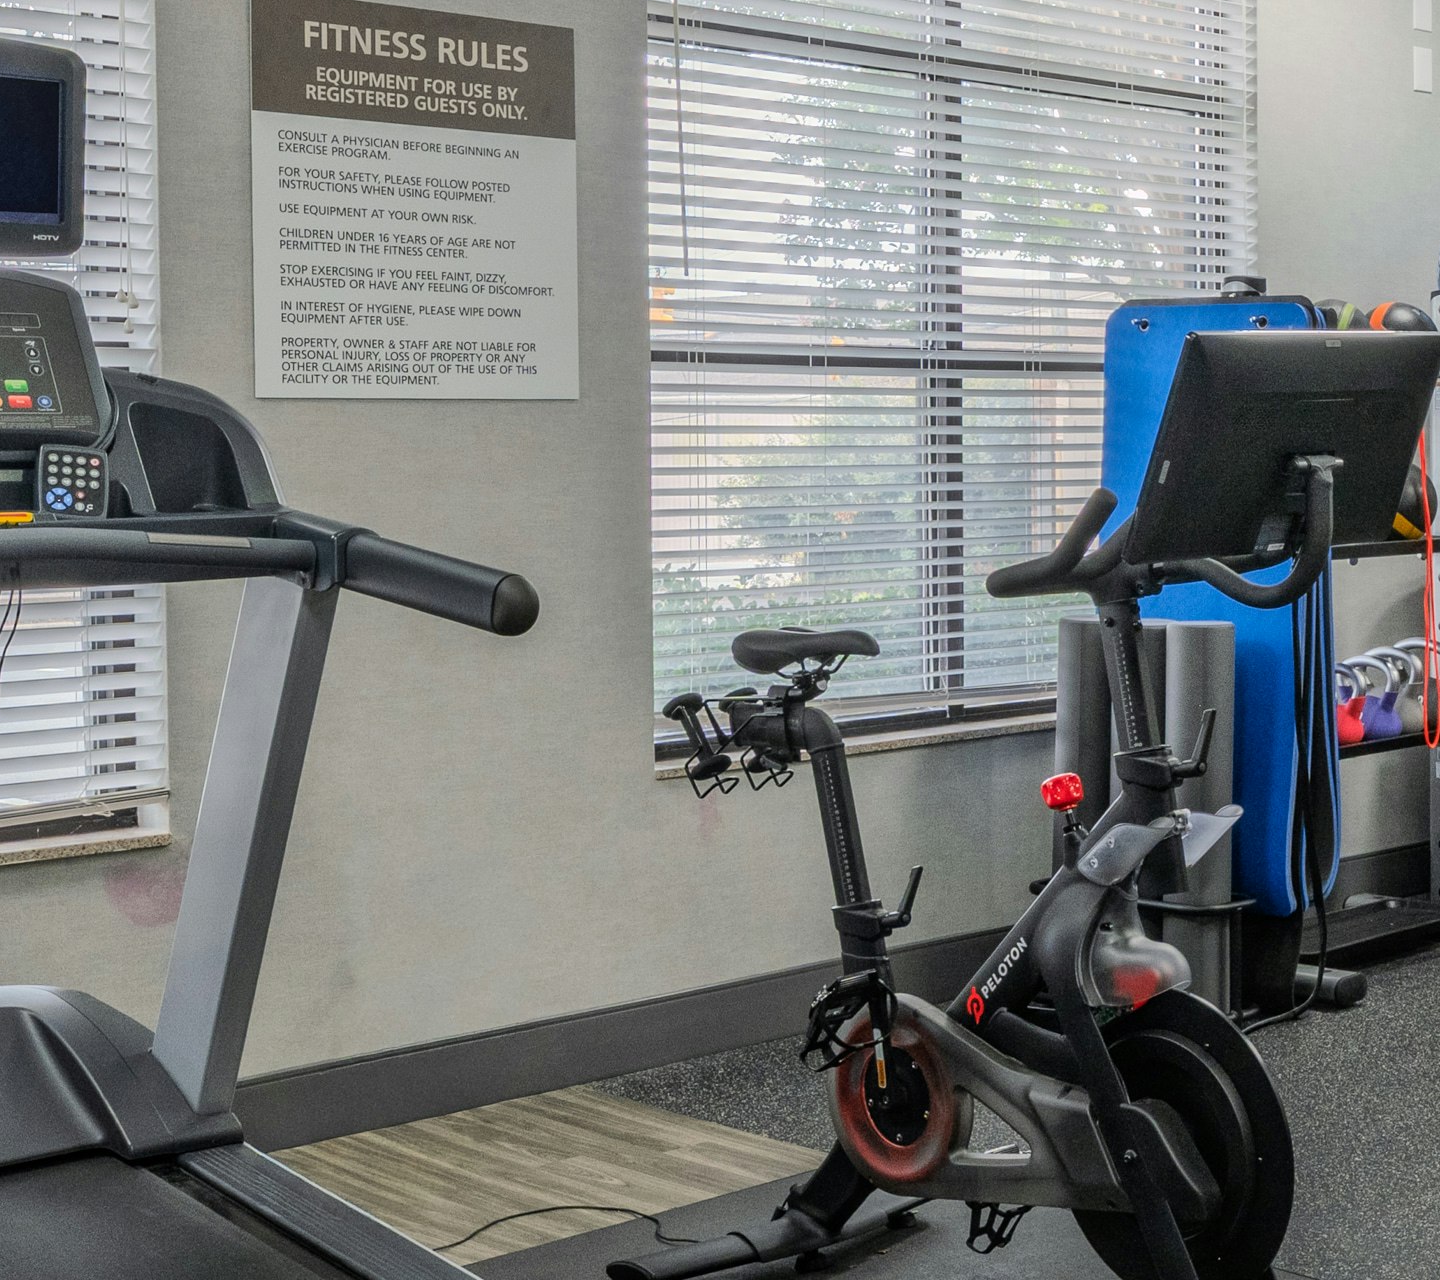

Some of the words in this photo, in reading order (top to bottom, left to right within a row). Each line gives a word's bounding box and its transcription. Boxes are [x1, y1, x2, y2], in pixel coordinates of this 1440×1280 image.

[304, 20, 427, 61] FITNESS
[438, 37, 529, 73] RULES
[316, 66, 419, 92] EQUIPMENT
[424, 78, 456, 96] FOR
[462, 82, 492, 100] USE
[497, 86, 518, 102] BY
[306, 84, 409, 109] REGISTERED
[414, 95, 477, 116] GUESTS
[482, 102, 528, 121] ONLY.
[277, 129, 328, 144] CONSULT
[330, 134, 340, 145] A
[342, 135, 400, 150] PHYSICIAN
[402, 140, 442, 153] BEFORE
[445, 144, 501, 158] BEGINNING
[504, 149, 520, 160] AN
[278, 141, 328, 156] EXERCISE
[331, 146, 391, 160] PROGRAM.
[278, 166, 301, 178] FOR
[304, 168, 336, 180] YOUR
[338, 170, 381, 185] SAFETY,
[384, 174, 422, 187] PLEASE
[425, 177, 469, 190] FOLLOW
[471, 180, 511, 193] POSTED
[278, 178, 358, 194] INSTRUCTIONS
[360, 184, 395, 197] WHEN
[398, 187, 431, 199] USING
[433, 189, 497, 203] EQUIPMENT.
[279, 203, 300, 214] USE
[303, 204, 368, 218] EQUIPMENT
[370, 208, 385, 219] AT
[387, 210, 419, 221] YOUR
[421, 212, 449, 223] OWN
[451, 214, 477, 225] RISK.
[278, 227, 334, 240] CHILDREN
[337, 230, 375, 243] UNDER
[378, 233, 390, 243] 16
[392, 233, 427, 246] YEARS
[429, 235, 444, 246] OF
[446, 236, 468, 248] AGE
[471, 238, 491, 249] ARE
[494, 239, 516, 250] NOT
[279, 239, 342, 253] PERMITTED
[344, 243, 356, 253] IN
[359, 243, 380, 255] THE
[383, 244, 424, 257] FITNESS
[425, 247, 468, 259] CENTER.
[279, 263, 309, 275] STOP
[311, 265, 374, 278] EXERCISING
[377, 268, 386, 278] IF
[388, 268, 413, 280] YOU
[415, 270, 438, 281] FEEL
[441, 271, 473, 284] FAINT,
[475, 272, 507, 285] DIZZY,
[280, 275, 346, 289] EXHAUSTED
[348, 278, 366, 289] OR
[368, 280, 398, 291] HAVE
[401, 281, 425, 292] ANY
[427, 282, 469, 294] FEELING
[471, 284, 486, 294] OF
[488, 284, 556, 297] DISCOMFORT.
[280, 300, 292, 311] IN
[295, 301, 346, 313] INTEREST
[348, 302, 363, 313] OF
[366, 303, 416, 316] HYGIENE,
[418, 305, 456, 316] PLEASE
[458, 306, 484, 317] WIPE
[487, 307, 521, 318] DOWN
[280, 312, 346, 324] EQUIPMENT
[349, 314, 383, 326] AFTER
[385, 315, 409, 326] USE.
[281, 336, 340, 350] PROPERTY,
[342, 338, 385, 350] OWNER
[387, 339, 396, 350] &
[398, 339, 429, 350] STAFF
[431, 340, 453, 351] ARE
[455, 341, 478, 352] NOT
[480, 341, 514, 352] LIABLE
[516, 342, 536, 353] FOR
[281, 349, 339, 361] PERSONAL
[342, 350, 382, 363] INJURY,
[384, 351, 410, 362] LOSS
[412, 352, 427, 362] OF
[430, 352, 483, 363] PROPERTY
[485, 353, 501, 363] OR
[503, 353, 526, 364] ANY
[281, 361, 319, 372] OTHER
[321, 362, 364, 373] CLAIMS
[366, 363, 409, 374] ARISING
[412, 363, 435, 374] OUT
[437, 364, 452, 374] OF
[454, 364, 475, 374] THE
[477, 364, 497, 375] USE
[499, 365, 513, 375] OF
[515, 365, 538, 375] THIS
[281, 373, 329, 384] FACILITY
[331, 374, 348, 385] OR
[351, 374, 372, 385] THE
[375, 374, 441, 386] EQUIPMENT.
[980, 936, 1028, 999] PELOTON
